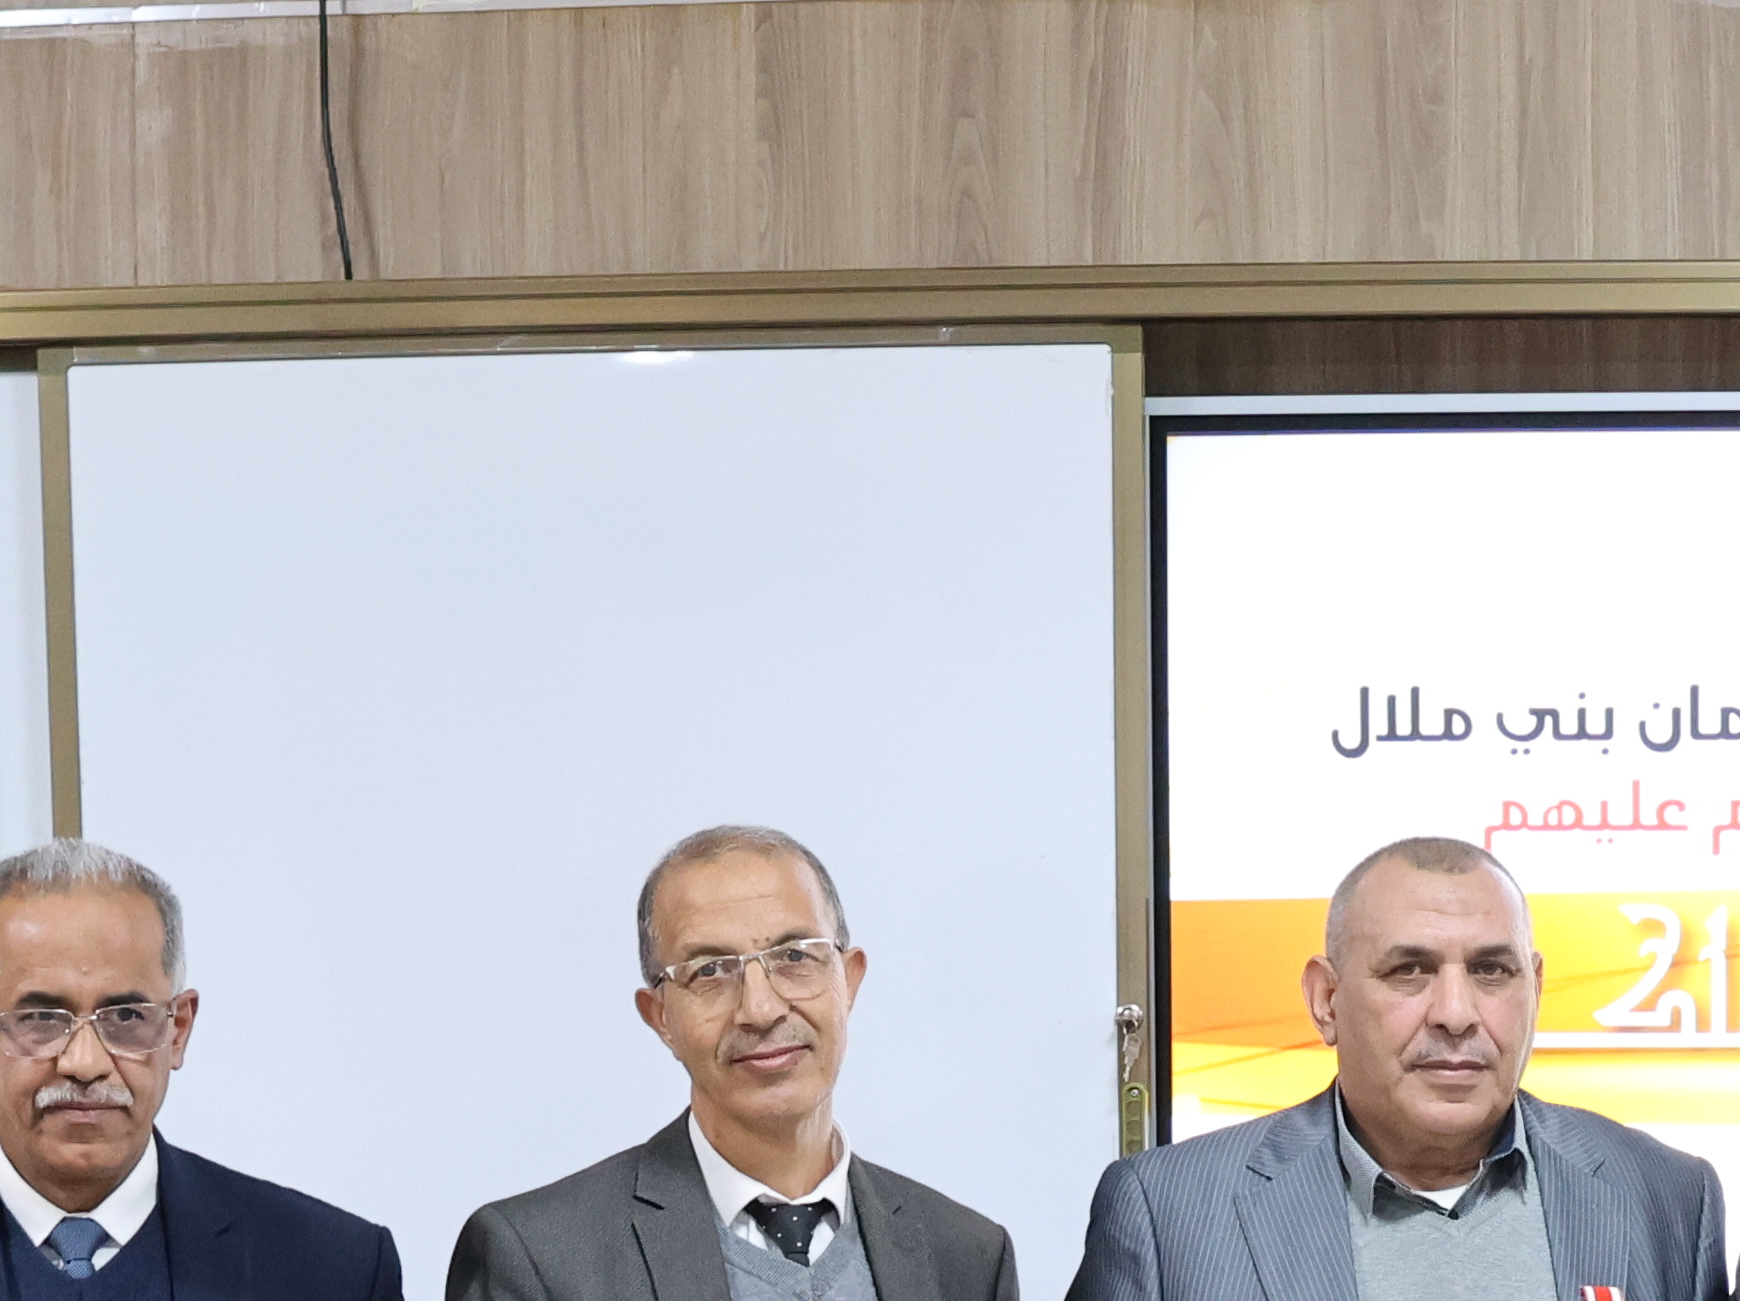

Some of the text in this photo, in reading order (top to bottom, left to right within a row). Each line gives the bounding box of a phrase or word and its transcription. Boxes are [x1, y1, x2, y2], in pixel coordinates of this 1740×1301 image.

[1332, 686, 1473, 759] ملال
[1496, 692, 1614, 756] بني
[1483, 779, 1689, 851] عليهم
